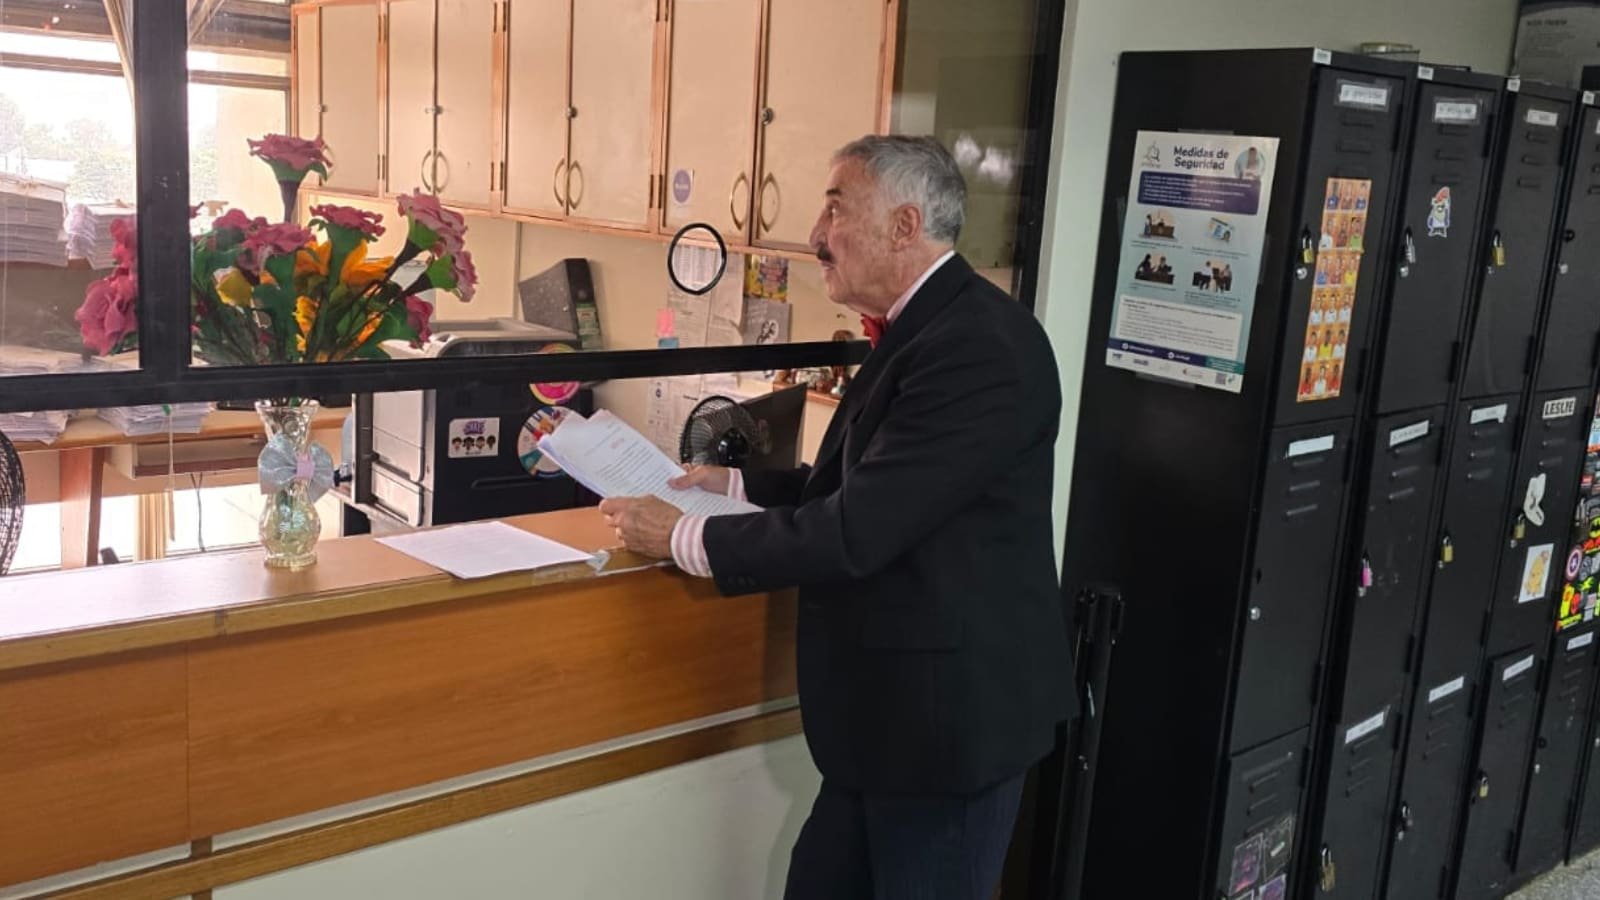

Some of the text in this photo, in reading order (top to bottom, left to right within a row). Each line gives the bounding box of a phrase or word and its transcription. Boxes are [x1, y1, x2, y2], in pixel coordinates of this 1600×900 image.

[1173, 146, 1229, 159] Medidas de
[1174, 157, 1225, 170] Seguridad
[1544, 400, 1574, 416] LESLIE
